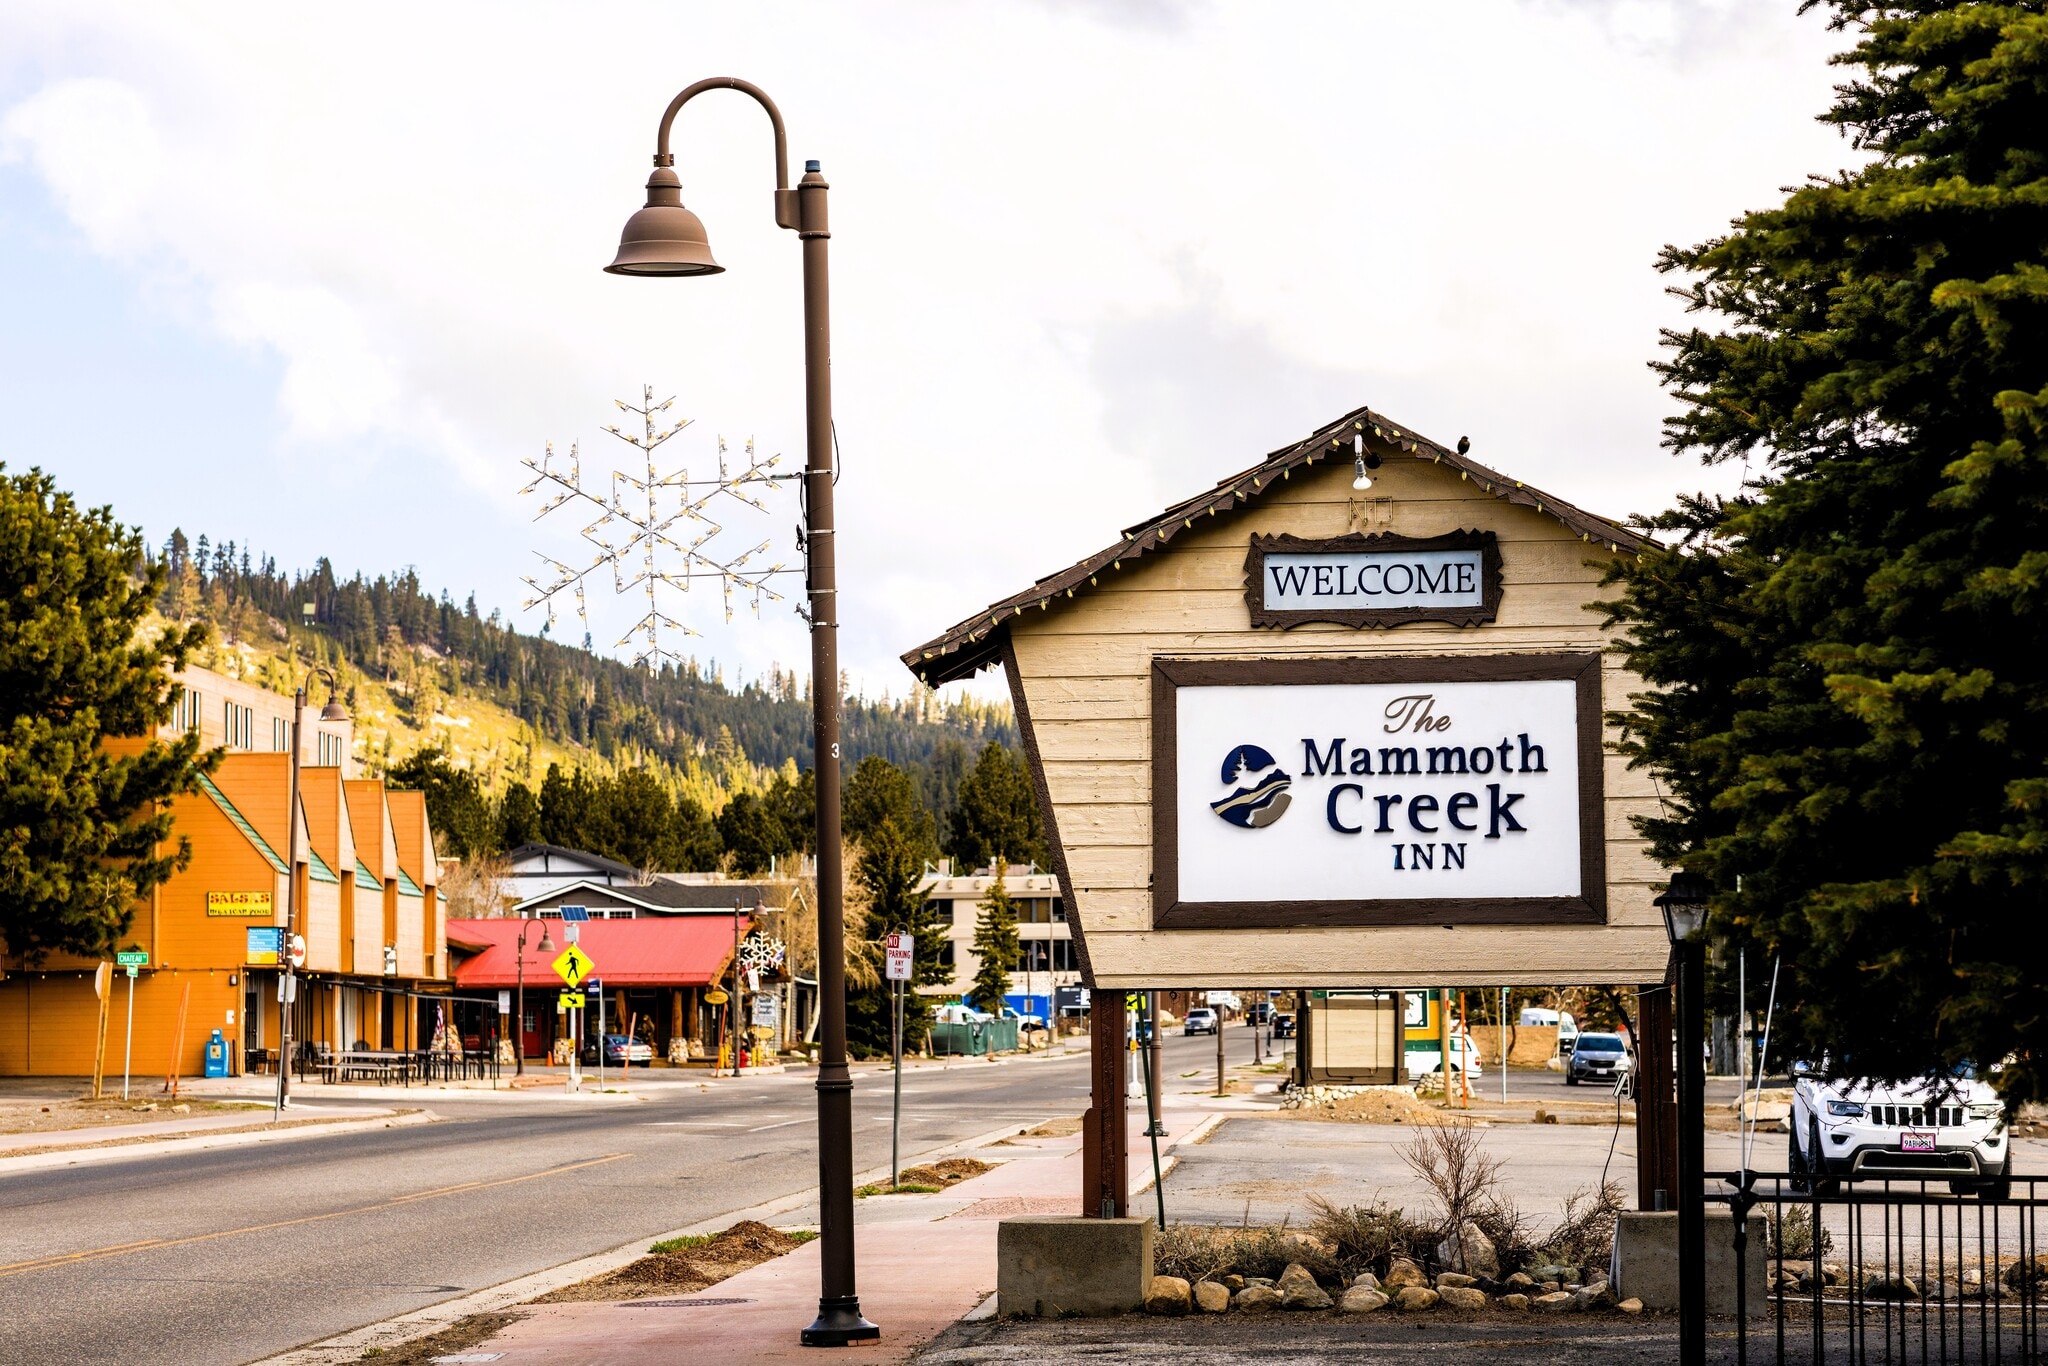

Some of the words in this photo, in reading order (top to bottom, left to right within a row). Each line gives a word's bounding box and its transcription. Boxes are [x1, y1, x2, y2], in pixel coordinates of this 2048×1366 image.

[1270, 563, 1475, 596] WELCOME
[1383, 694, 1452, 734] The
[831, 742, 840, 759] 3
[1301, 733, 1549, 776] Mammoth
[1326, 783, 1528, 839] Creek
[1391, 843, 1467, 870] INN
[888, 936, 898, 947] NO
[119, 954, 142, 963] CHATEAU
[888, 949, 911, 960] PARKING
[894, 959, 904, 967] ANY
[894, 967, 904, 975] TIME
